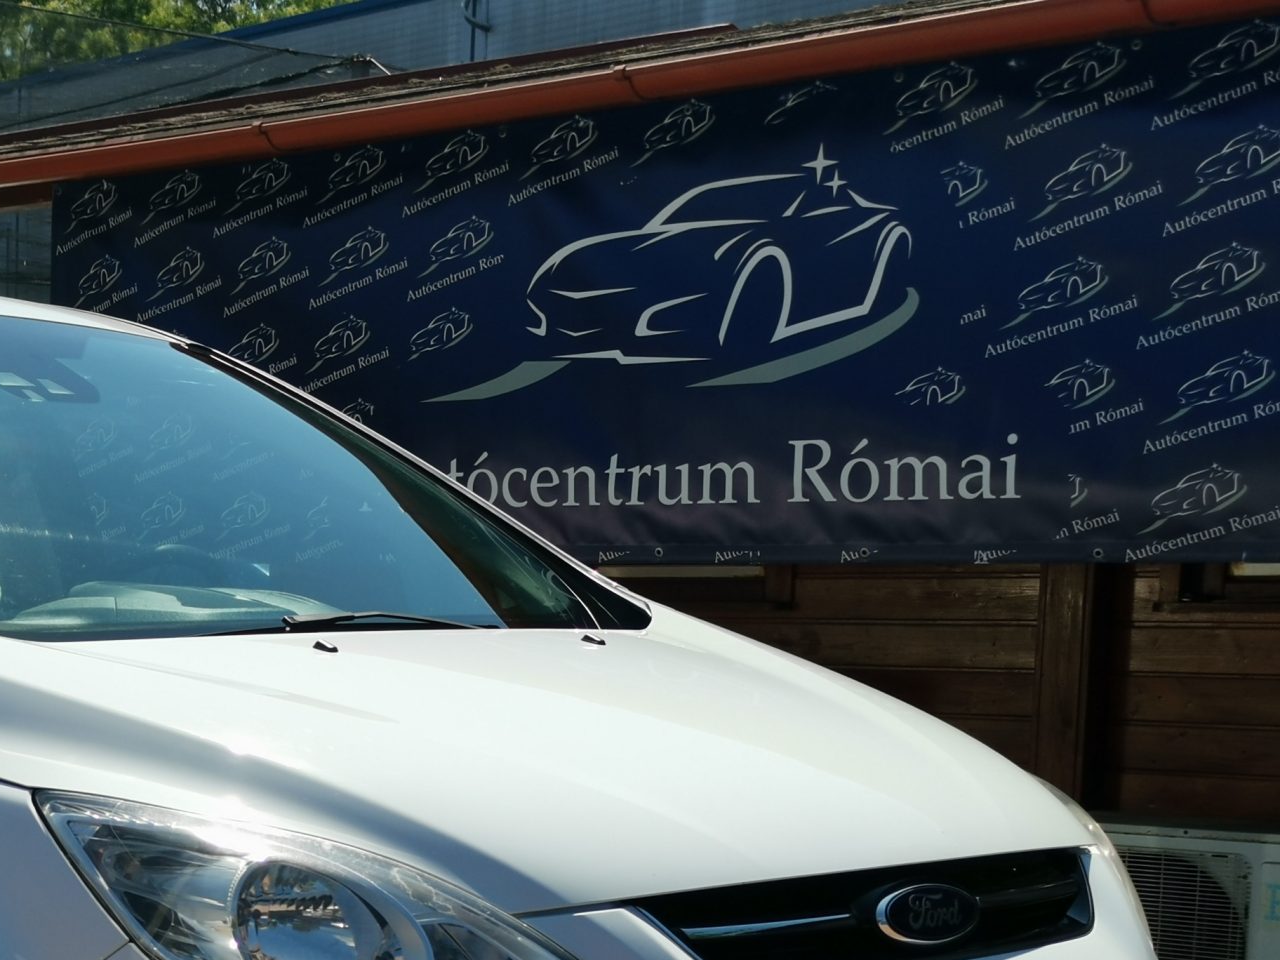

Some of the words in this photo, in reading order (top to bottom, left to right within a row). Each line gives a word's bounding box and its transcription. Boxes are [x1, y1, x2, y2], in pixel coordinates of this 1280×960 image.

[1004, 103, 1099, 150] Autócentrum
[1151, 81, 1257, 131] Autócentrum
[401, 179, 471, 218] Autócentrum
[474, 159, 509, 185] Római
[507, 166, 581, 207] Autócentrum
[583, 145, 619, 173] Római
[213, 203, 275, 239] Autócentrum
[276, 186, 308, 212] Római
[302, 191, 368, 229] Autócentrum
[371, 173, 404, 199] Római
[968, 197, 1016, 225] Római
[1013, 203, 1111, 251] Autócentrum
[1114, 180, 1164, 212] Római
[1162, 189, 1267, 237] Autócentrum
[223, 282, 277, 318] Autócentrum
[277, 266, 310, 292] Római
[308, 275, 372, 311] Autócentrum
[375, 257, 408, 281] Római
[406, 266, 477, 302] Autócentrum
[984, 314, 1084, 359] Autócentrum
[1087, 294, 1139, 326] Római
[1136, 305, 1241, 350] Autócentrum
[1095, 397, 1145, 426] Római
[1143, 412, 1248, 454] Autócentrum
[787, 433, 1021, 503] Római
[1072, 508, 1120, 534] Római
[1125, 526, 1225, 563] Autócentrum
[908, 893, 961, 929] Ford
